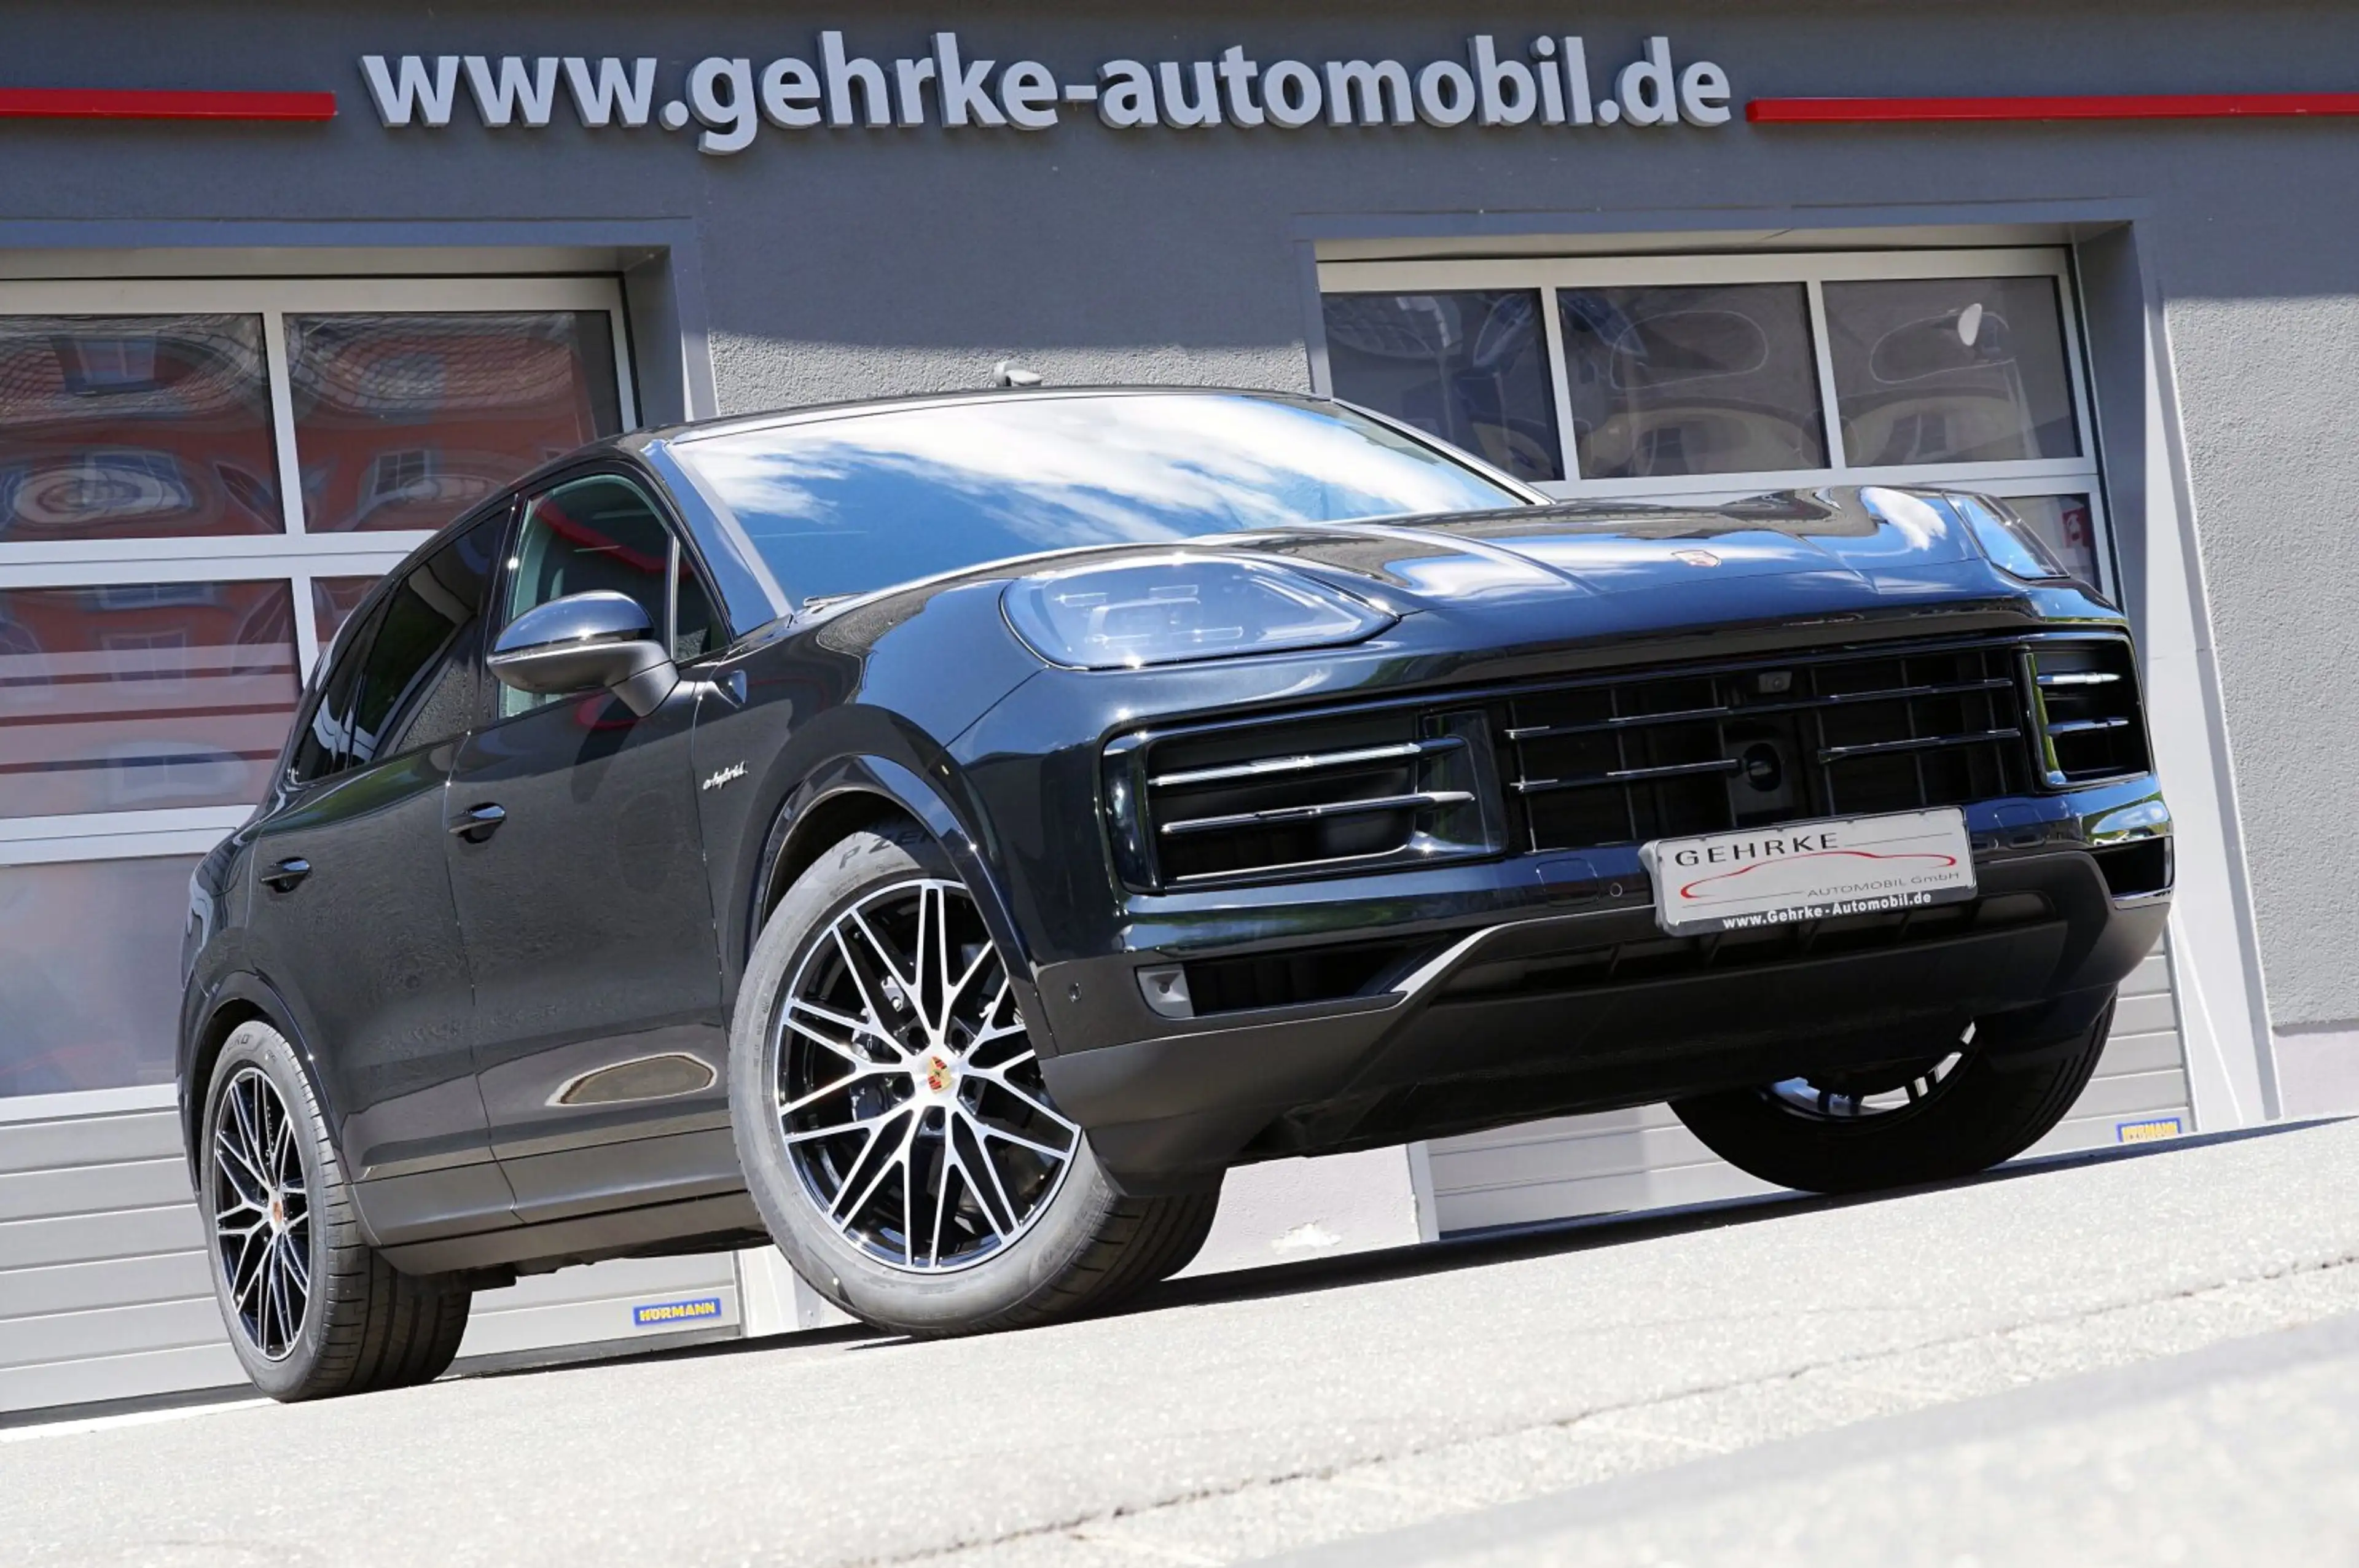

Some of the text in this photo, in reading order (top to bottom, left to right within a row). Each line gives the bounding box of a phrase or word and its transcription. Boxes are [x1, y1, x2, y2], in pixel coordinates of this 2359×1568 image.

[358, 31, 1731, 155] www.gehrke-automobil.de
[1675, 832, 1839, 866] GEHRKE
[1807, 872, 1960, 897] AUTOMOBIL GmbH
[1722, 892, 1931, 929] www.Gehrke-Automobil.de
